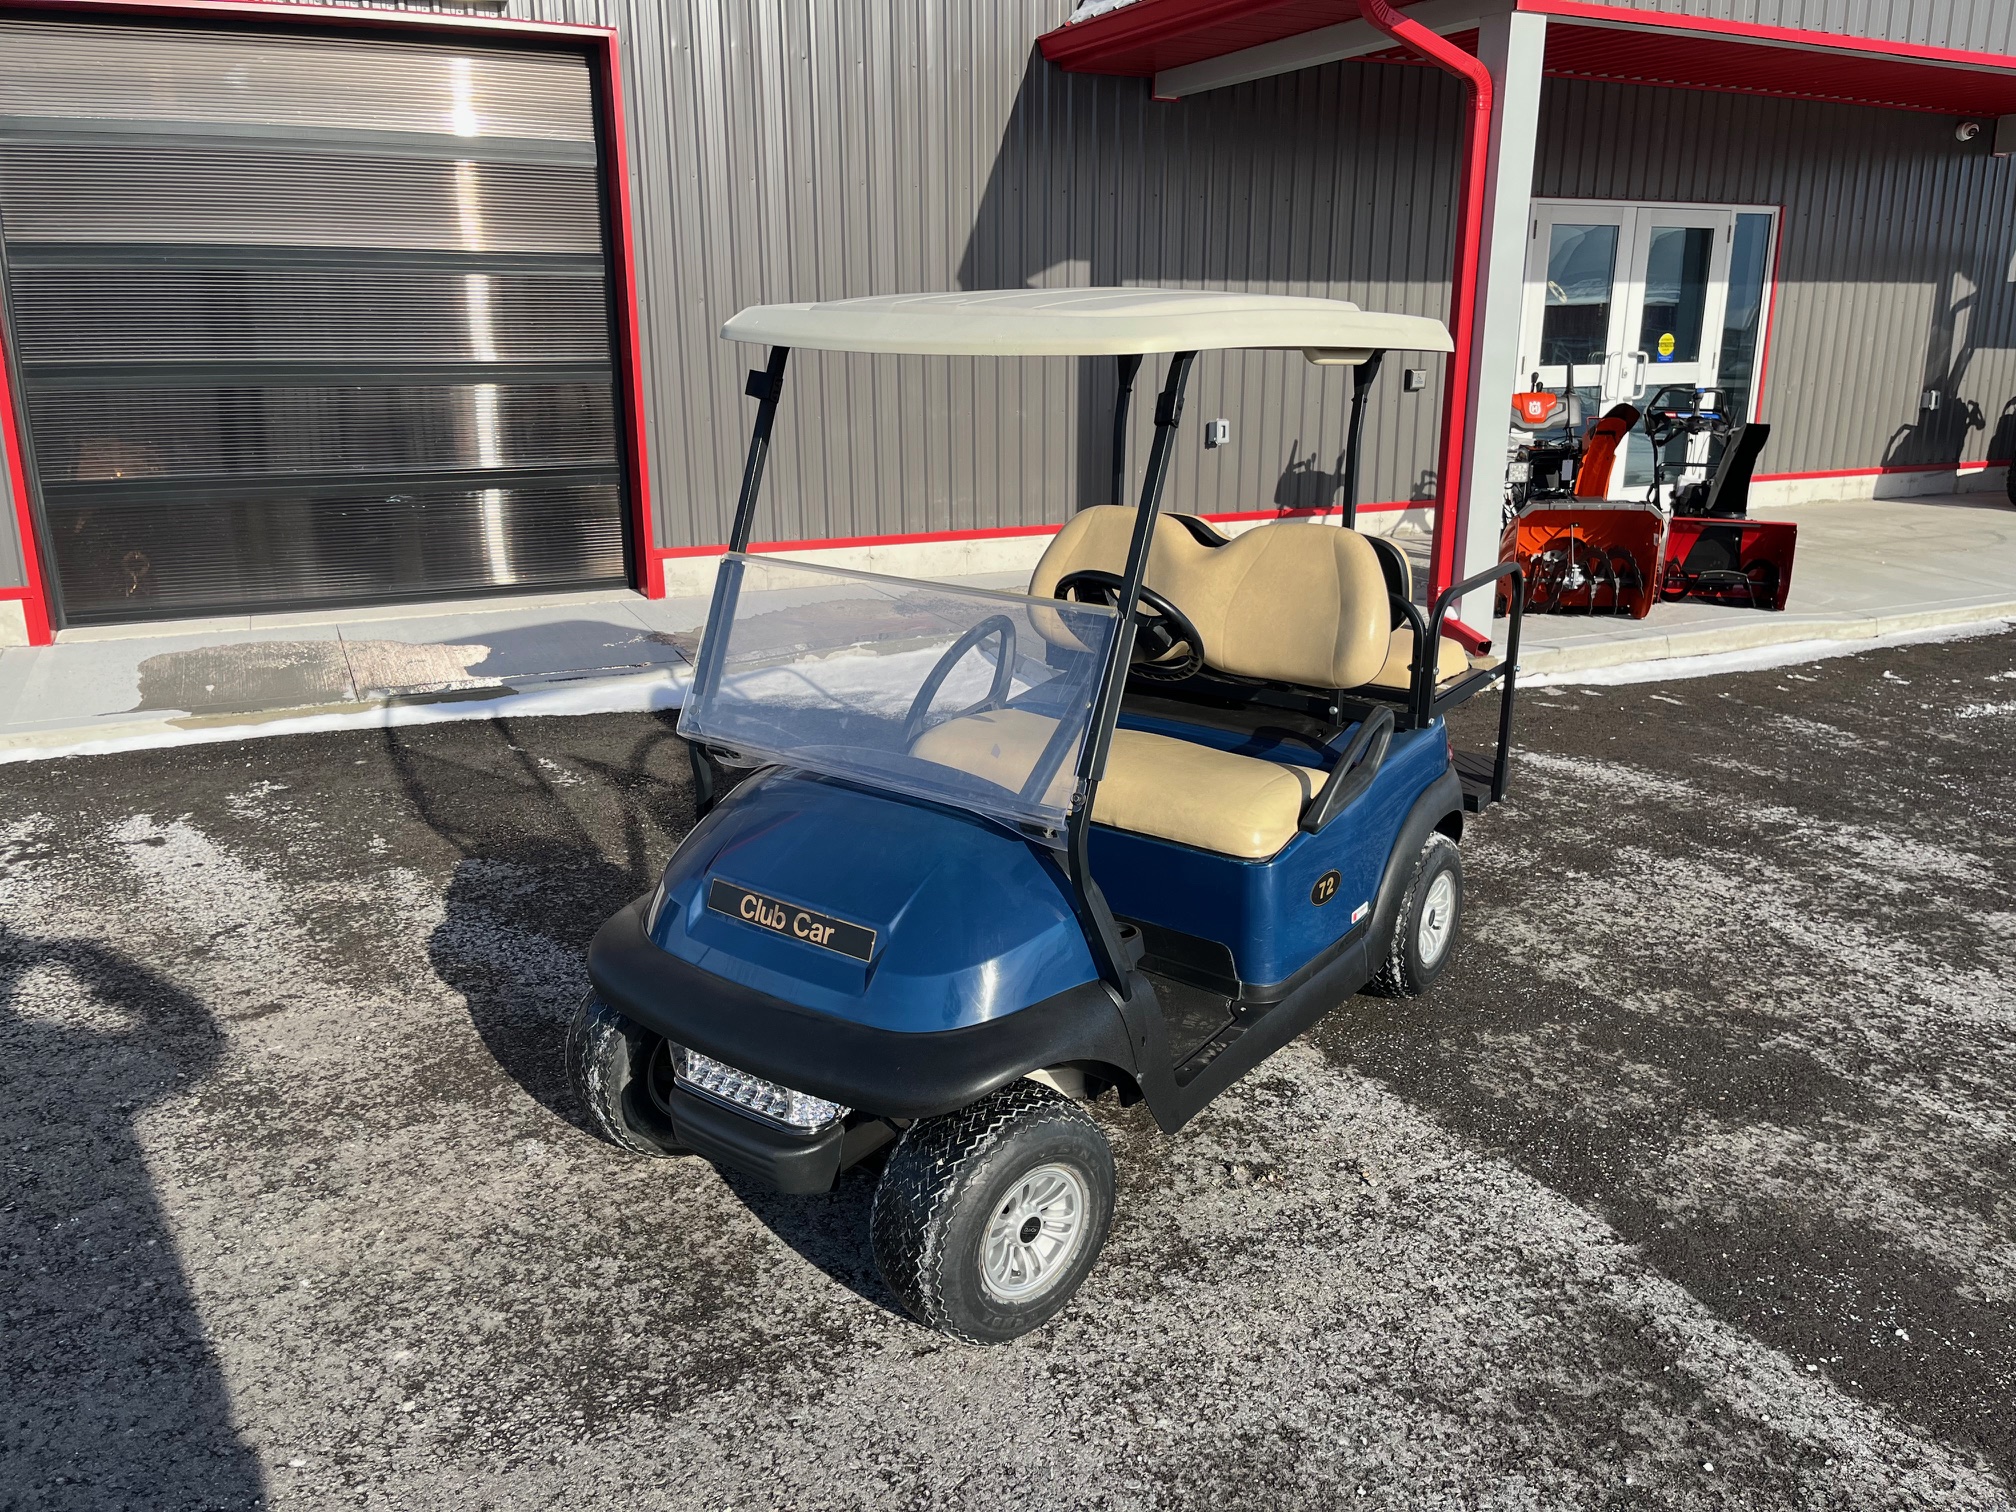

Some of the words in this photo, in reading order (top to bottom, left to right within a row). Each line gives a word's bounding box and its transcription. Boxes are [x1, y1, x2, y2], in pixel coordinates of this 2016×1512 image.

[1318, 876, 1335, 900] 72
[740, 894, 786, 930] Club
[793, 913, 835, 945] Car
